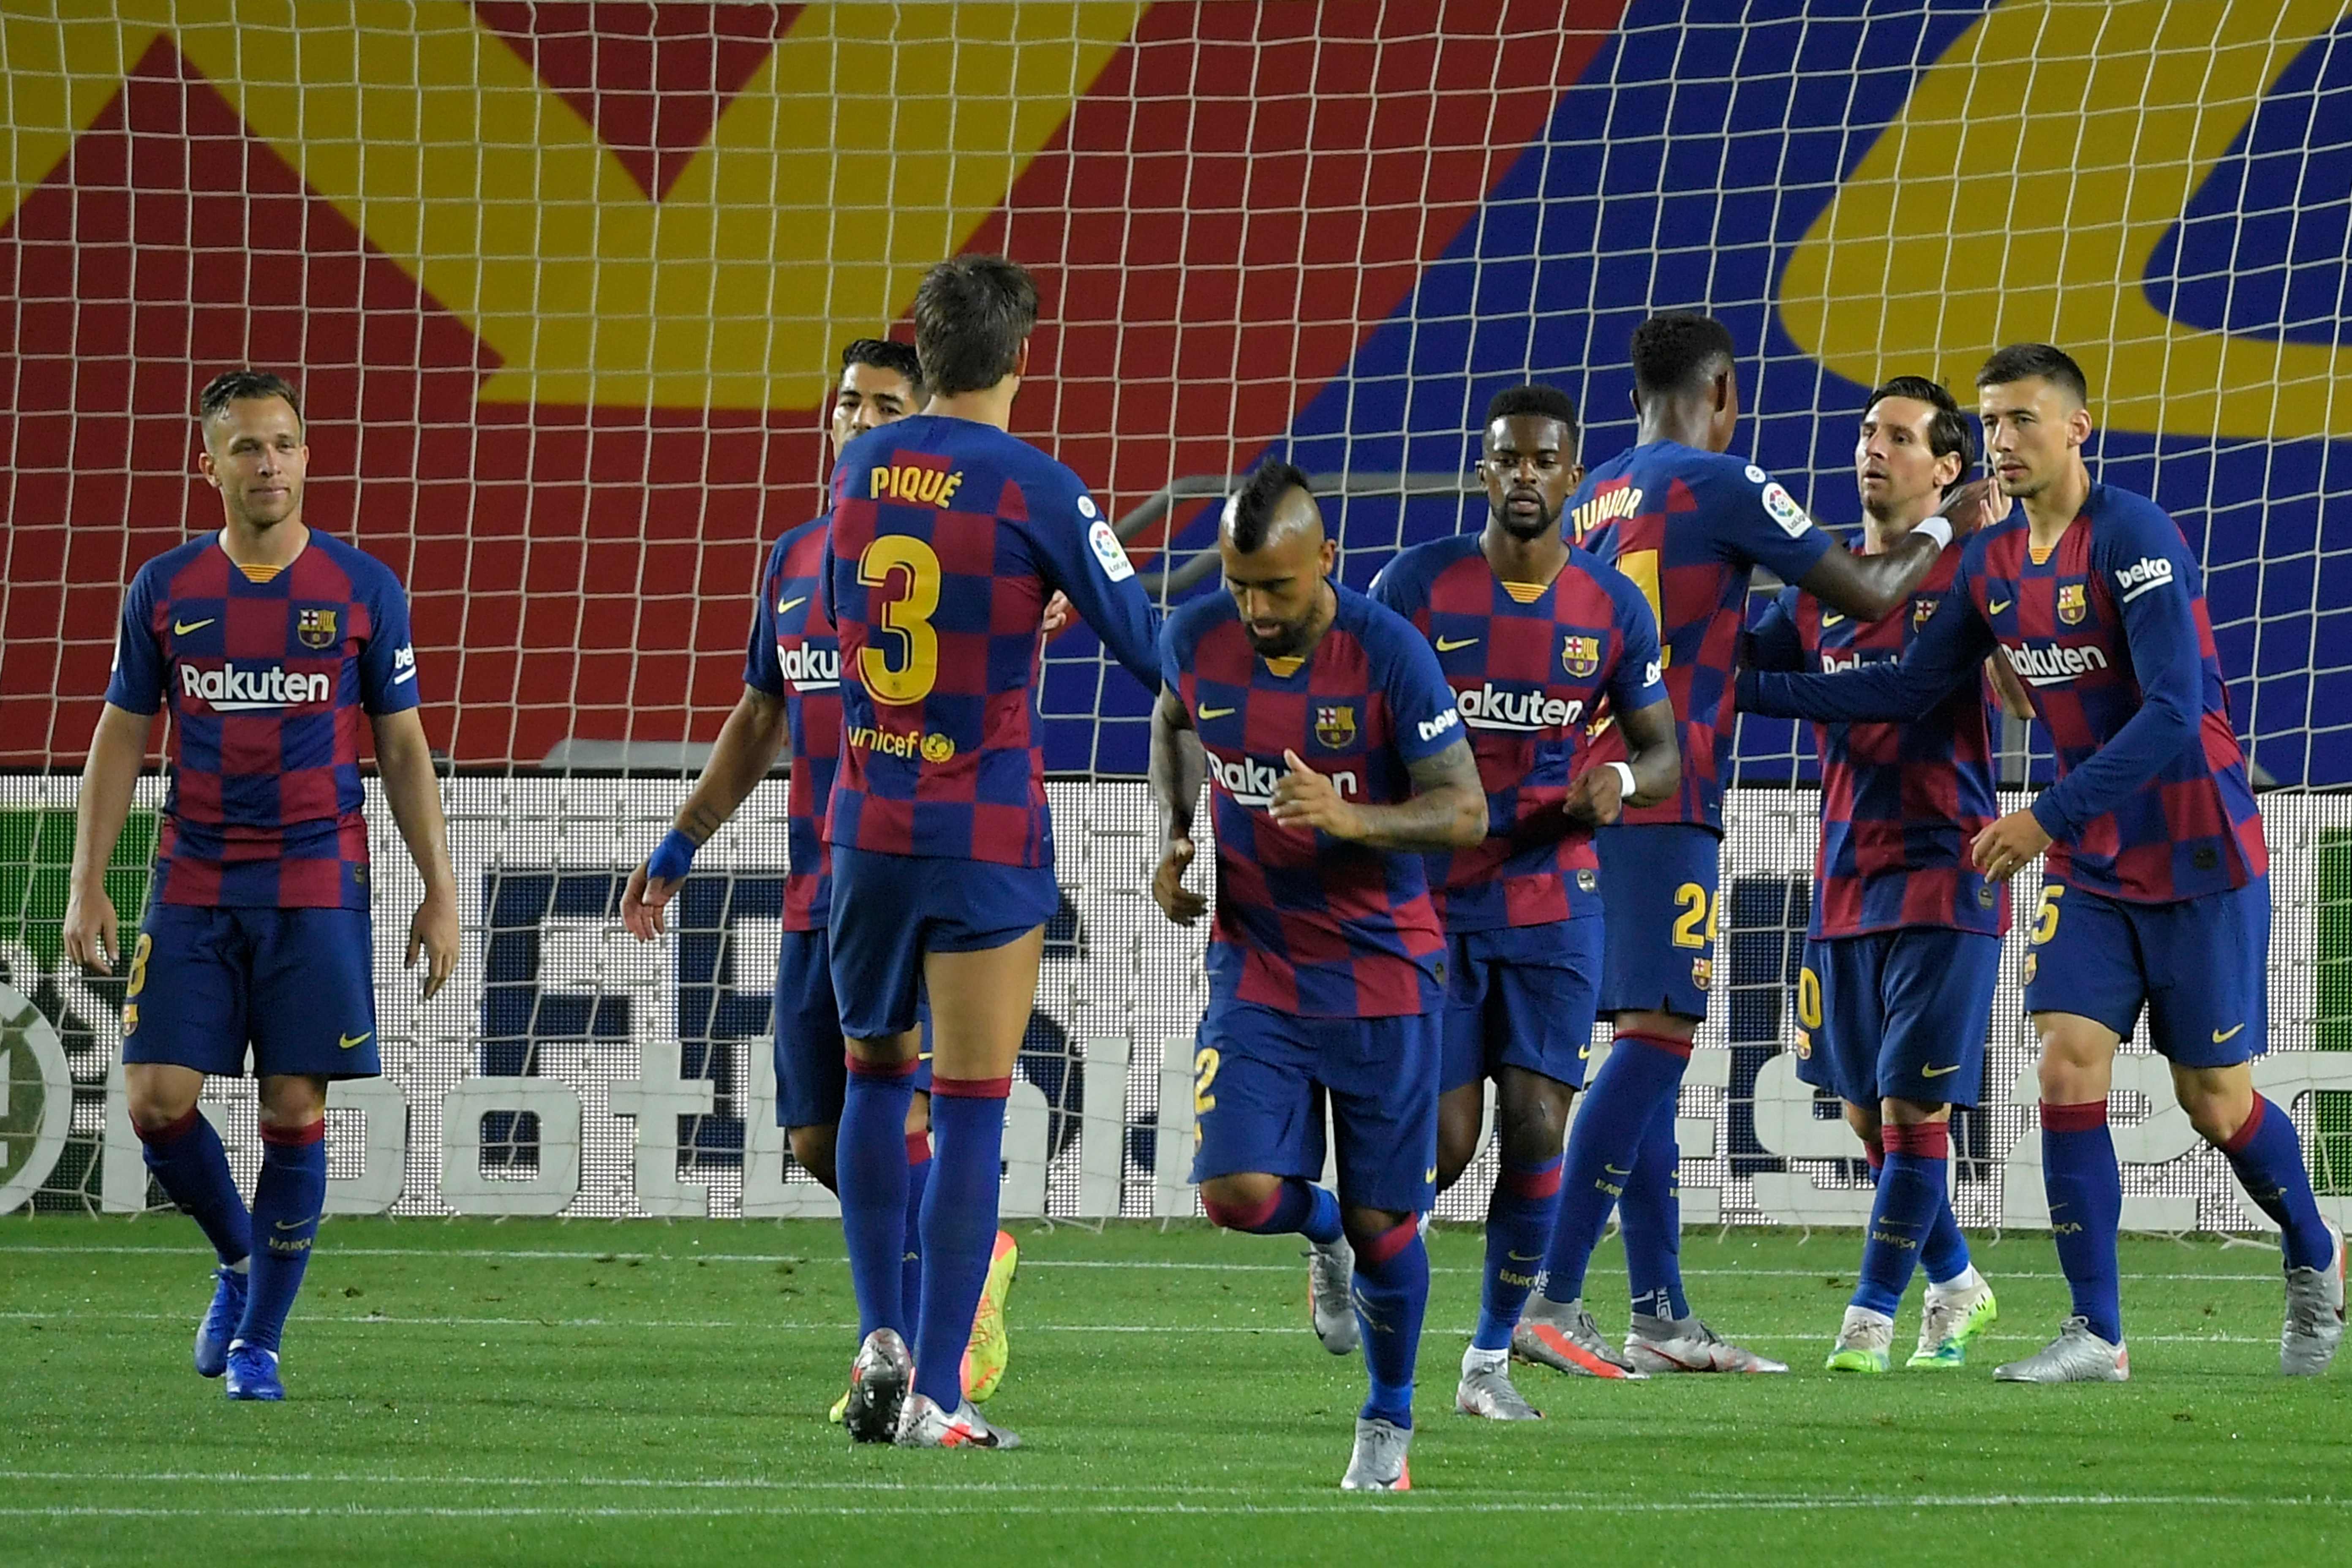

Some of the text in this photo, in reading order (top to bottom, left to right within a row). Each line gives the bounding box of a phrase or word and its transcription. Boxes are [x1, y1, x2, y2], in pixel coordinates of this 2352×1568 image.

[870, 466, 963, 509] PIQUÉ
[1571, 486, 1643, 544] JUNIOR
[2115, 557, 2172, 589] beko
[857, 534, 941, 706] 3
[777, 642, 840, 680] Raku
[2001, 642, 2108, 675] Rakuten
[180, 663, 329, 702] Rakuten
[848, 725, 919, 758] unicef
[1206, 751, 1357, 795] Rakn
[2031, 885, 2065, 945] 5
[127, 932, 152, 998] 8
[1798, 967, 1822, 1029] 0
[1195, 1048, 1220, 1115] 2
